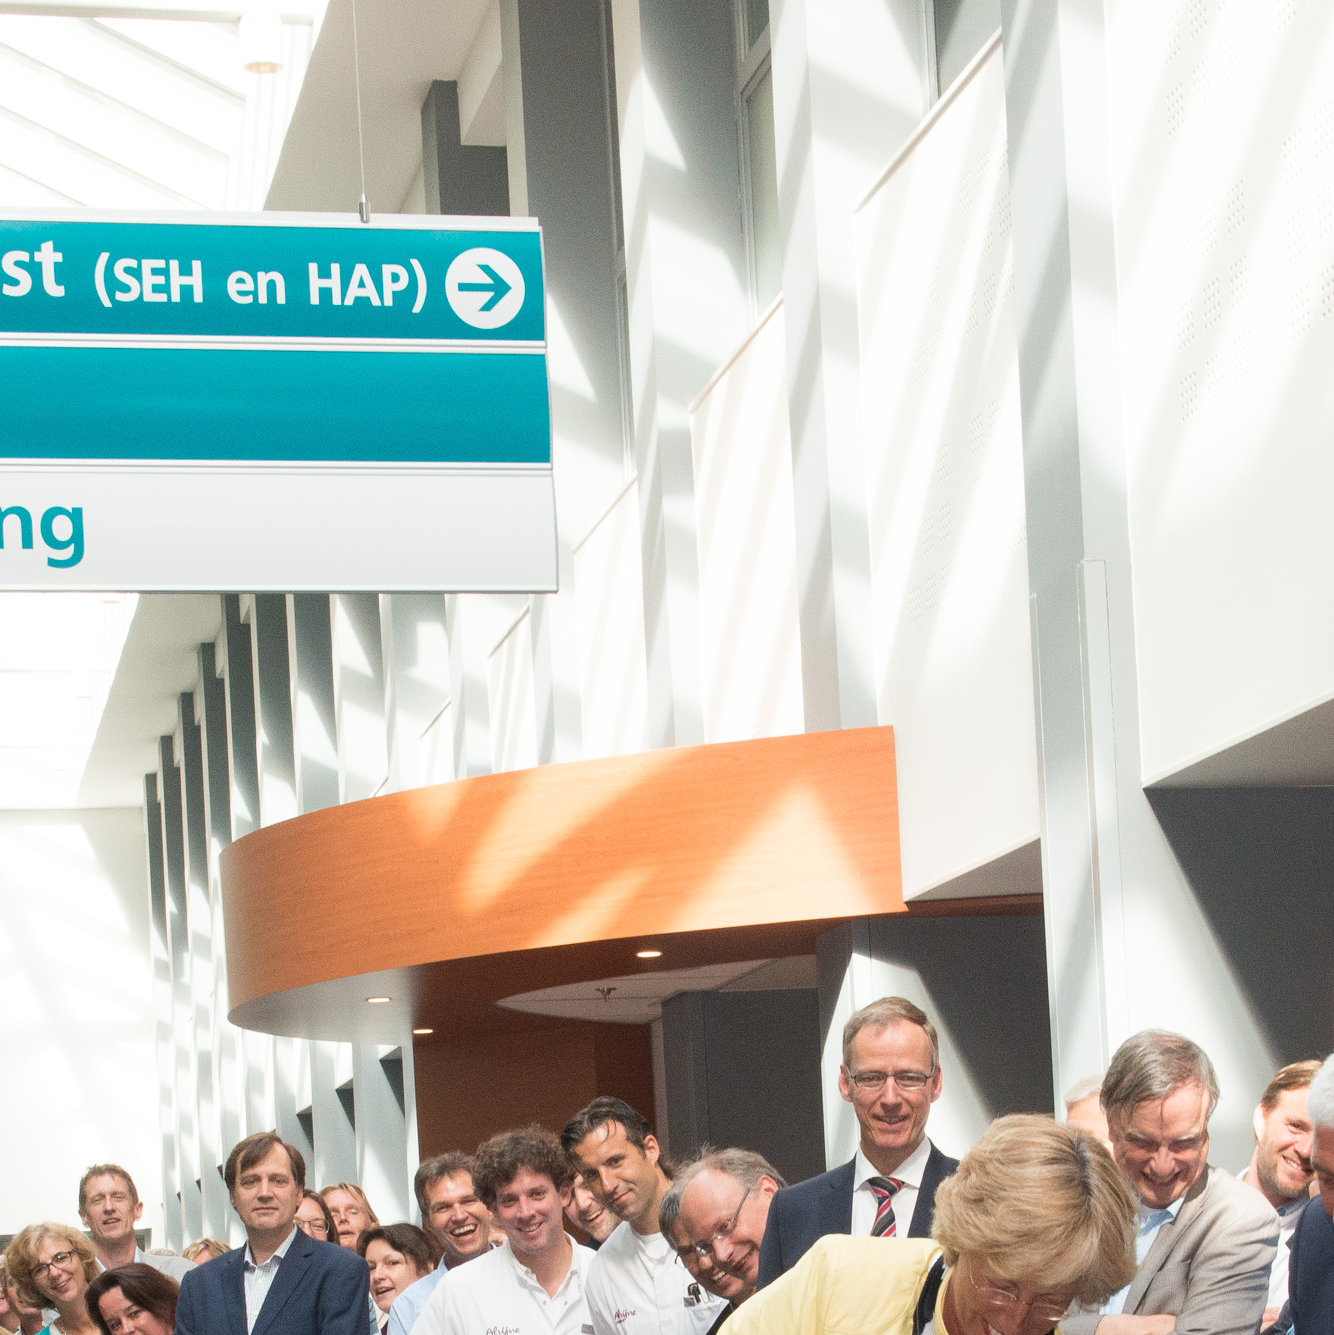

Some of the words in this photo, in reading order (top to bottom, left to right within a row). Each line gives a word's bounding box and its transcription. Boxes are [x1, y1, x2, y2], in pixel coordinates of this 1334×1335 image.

[94, 251, 205, 308] (SEH
[226, 270, 286, 305] en
[308, 259, 428, 314] HAP)
